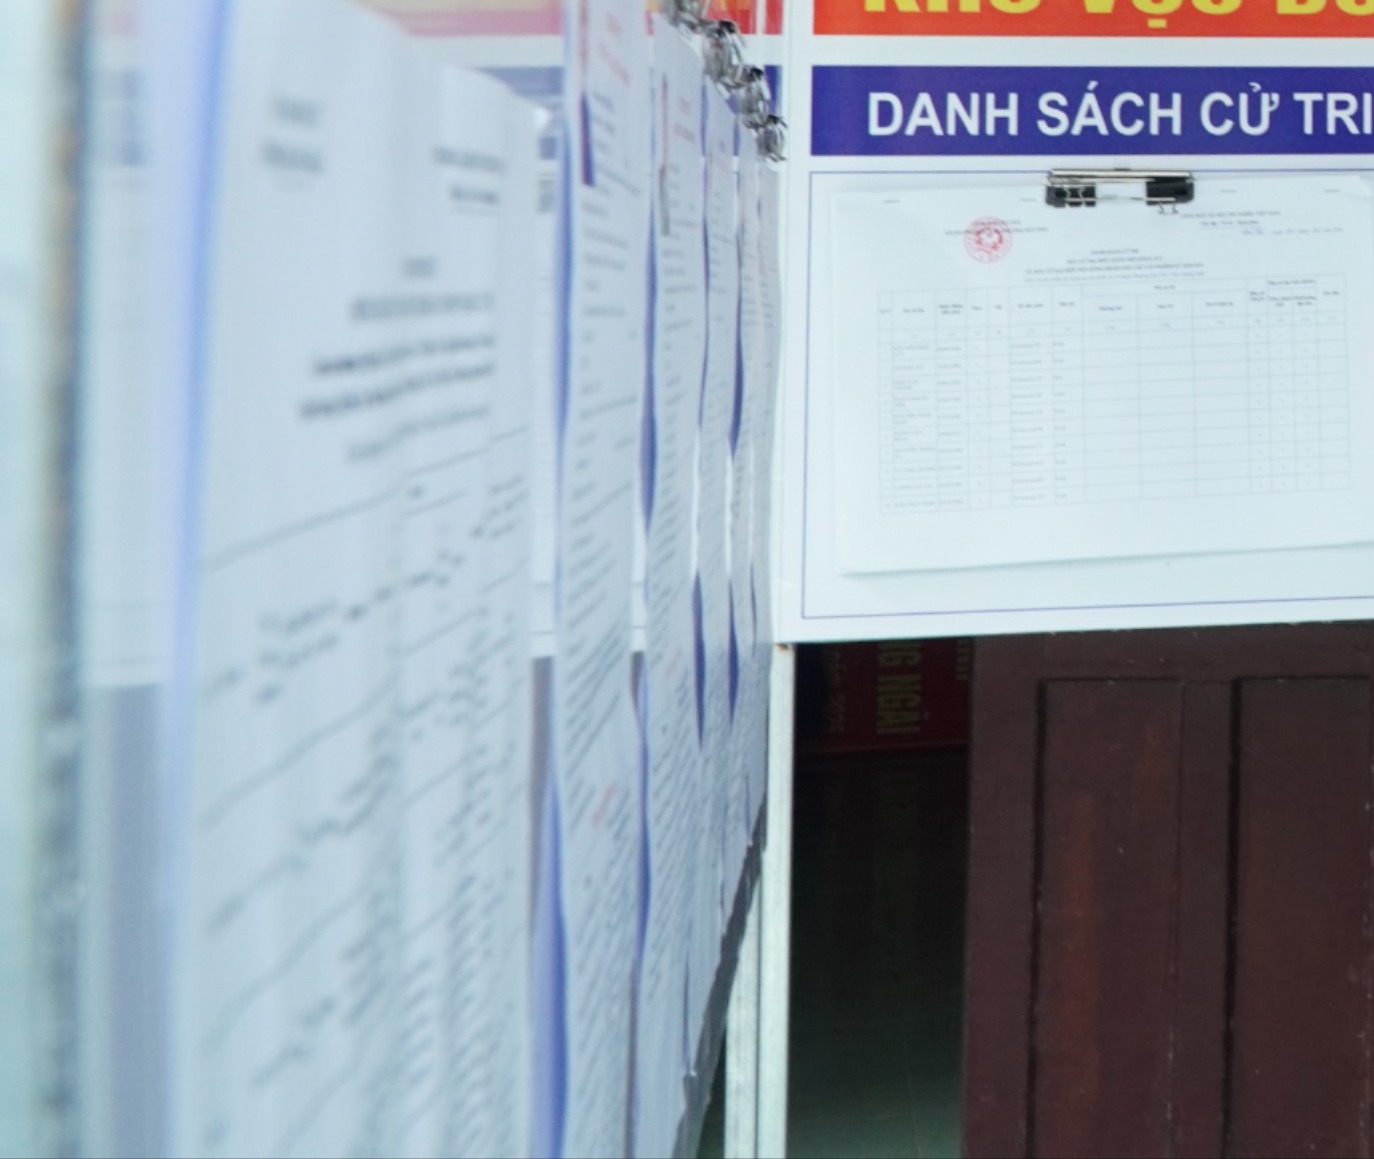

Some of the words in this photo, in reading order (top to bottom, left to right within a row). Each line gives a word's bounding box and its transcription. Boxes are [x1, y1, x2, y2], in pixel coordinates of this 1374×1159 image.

[868, 92, 1018, 136] DANH
[1037, 81, 1182, 136] SÁCH
[1199, 82, 1280, 136] CỬ
[1293, 92, 1373, 136] TRI
[876, 673, 929, 735] NGÃI
